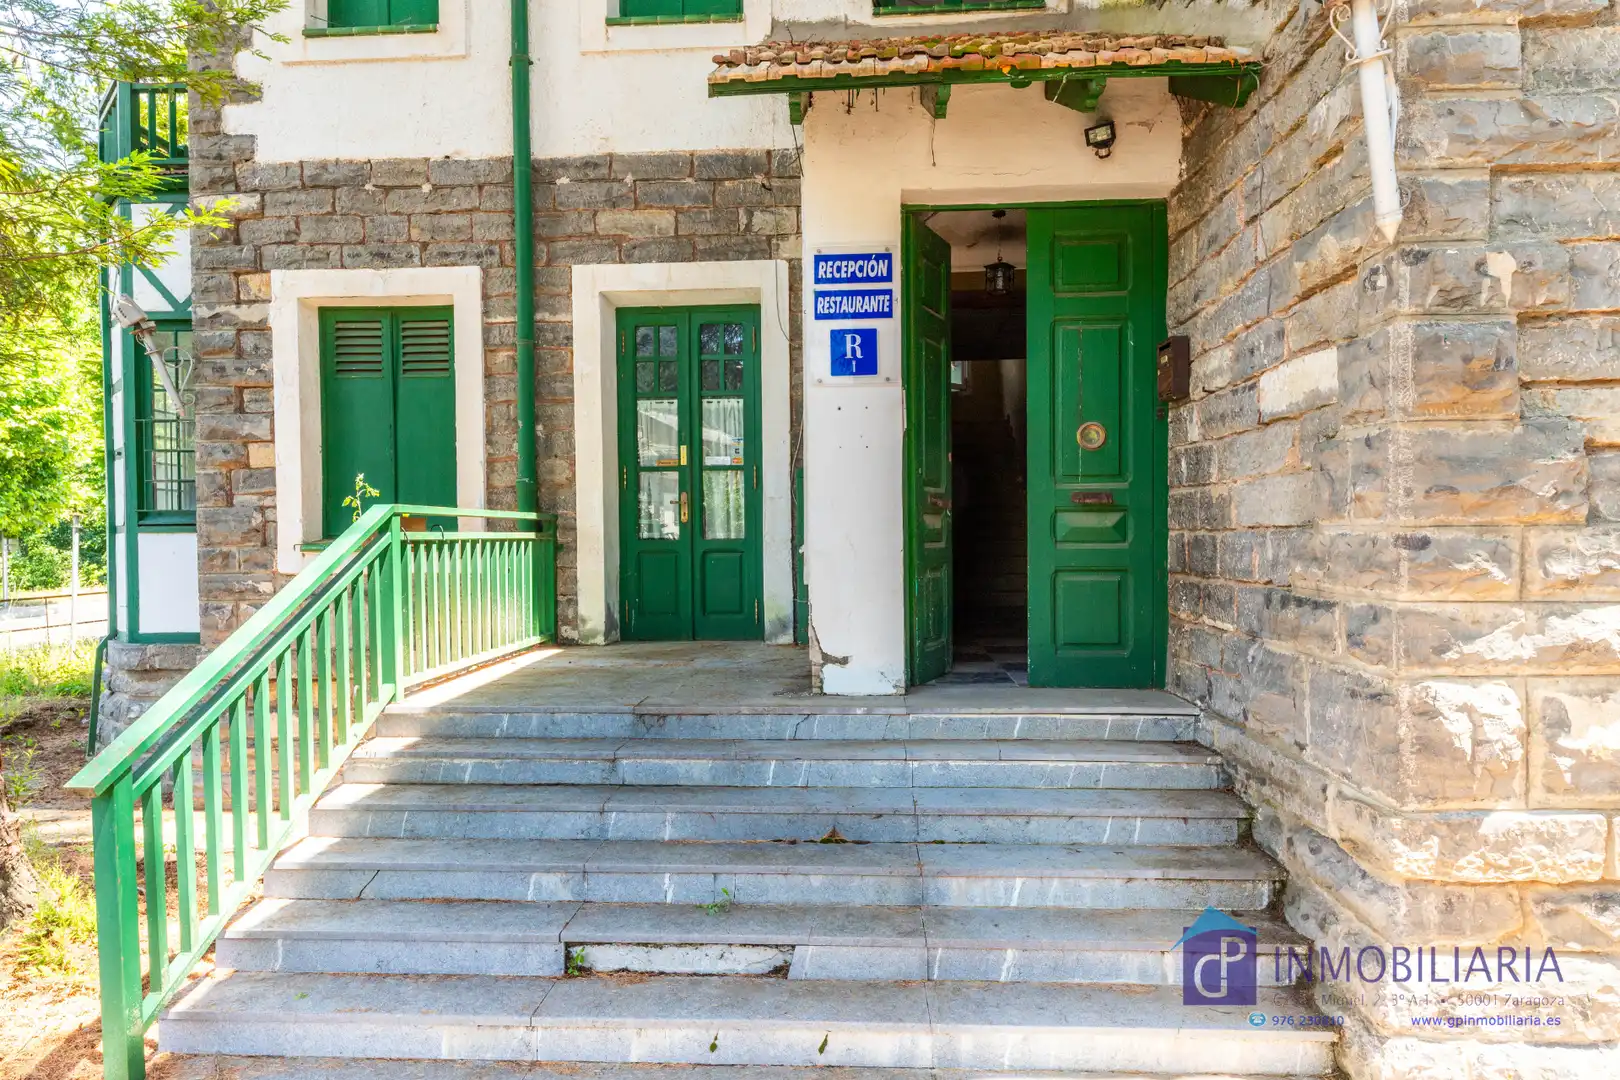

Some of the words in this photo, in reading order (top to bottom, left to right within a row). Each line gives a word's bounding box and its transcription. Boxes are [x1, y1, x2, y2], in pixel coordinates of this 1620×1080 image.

[818, 254, 889, 279] RECEPCIÓN
[817, 294, 890, 314] RESTAURANTE
[844, 333, 863, 359] R
